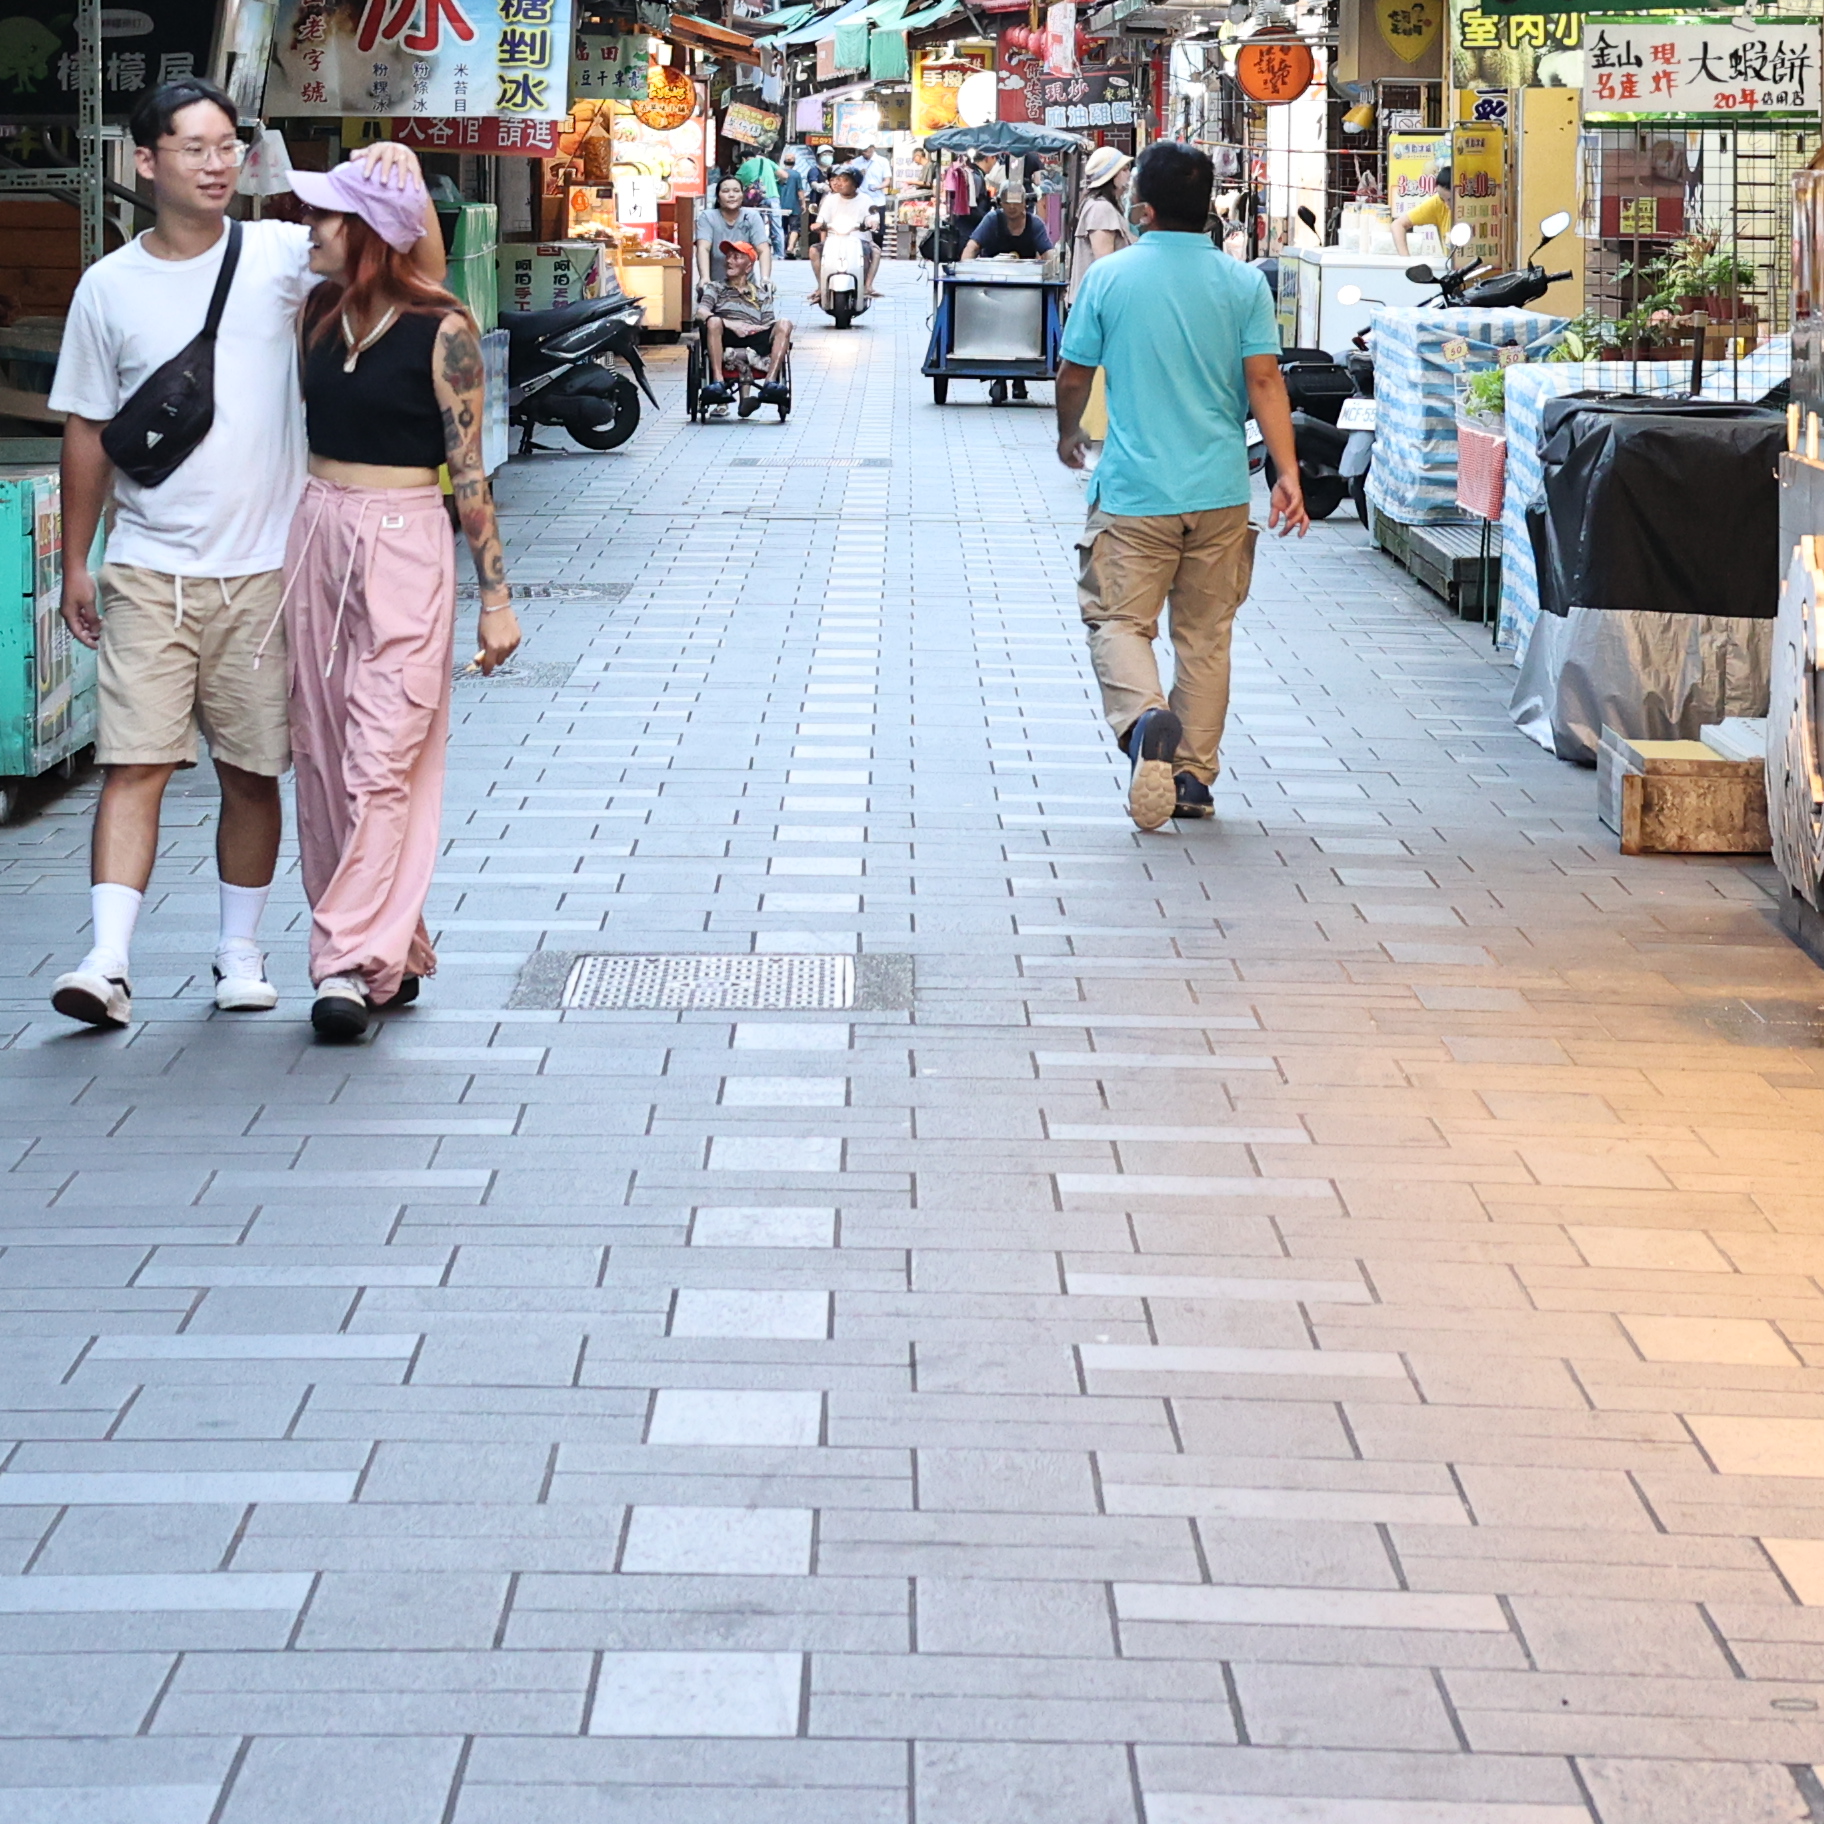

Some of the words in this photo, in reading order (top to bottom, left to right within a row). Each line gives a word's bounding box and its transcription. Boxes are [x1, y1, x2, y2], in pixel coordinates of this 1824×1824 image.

[1589, 29, 1643, 68] 金山
[922, 70, 976, 88] 手撥
[1687, 40, 1815, 95] 大蝦餅
[454, 63, 469, 113] 米苔目
[1044, 79, 1090, 102] 現炒
[1592, 73, 1642, 102] 名產
[497, 117, 553, 150] 請進
[1451, 345, 1463, 355] 50
[1505, 353, 1519, 364] 50
